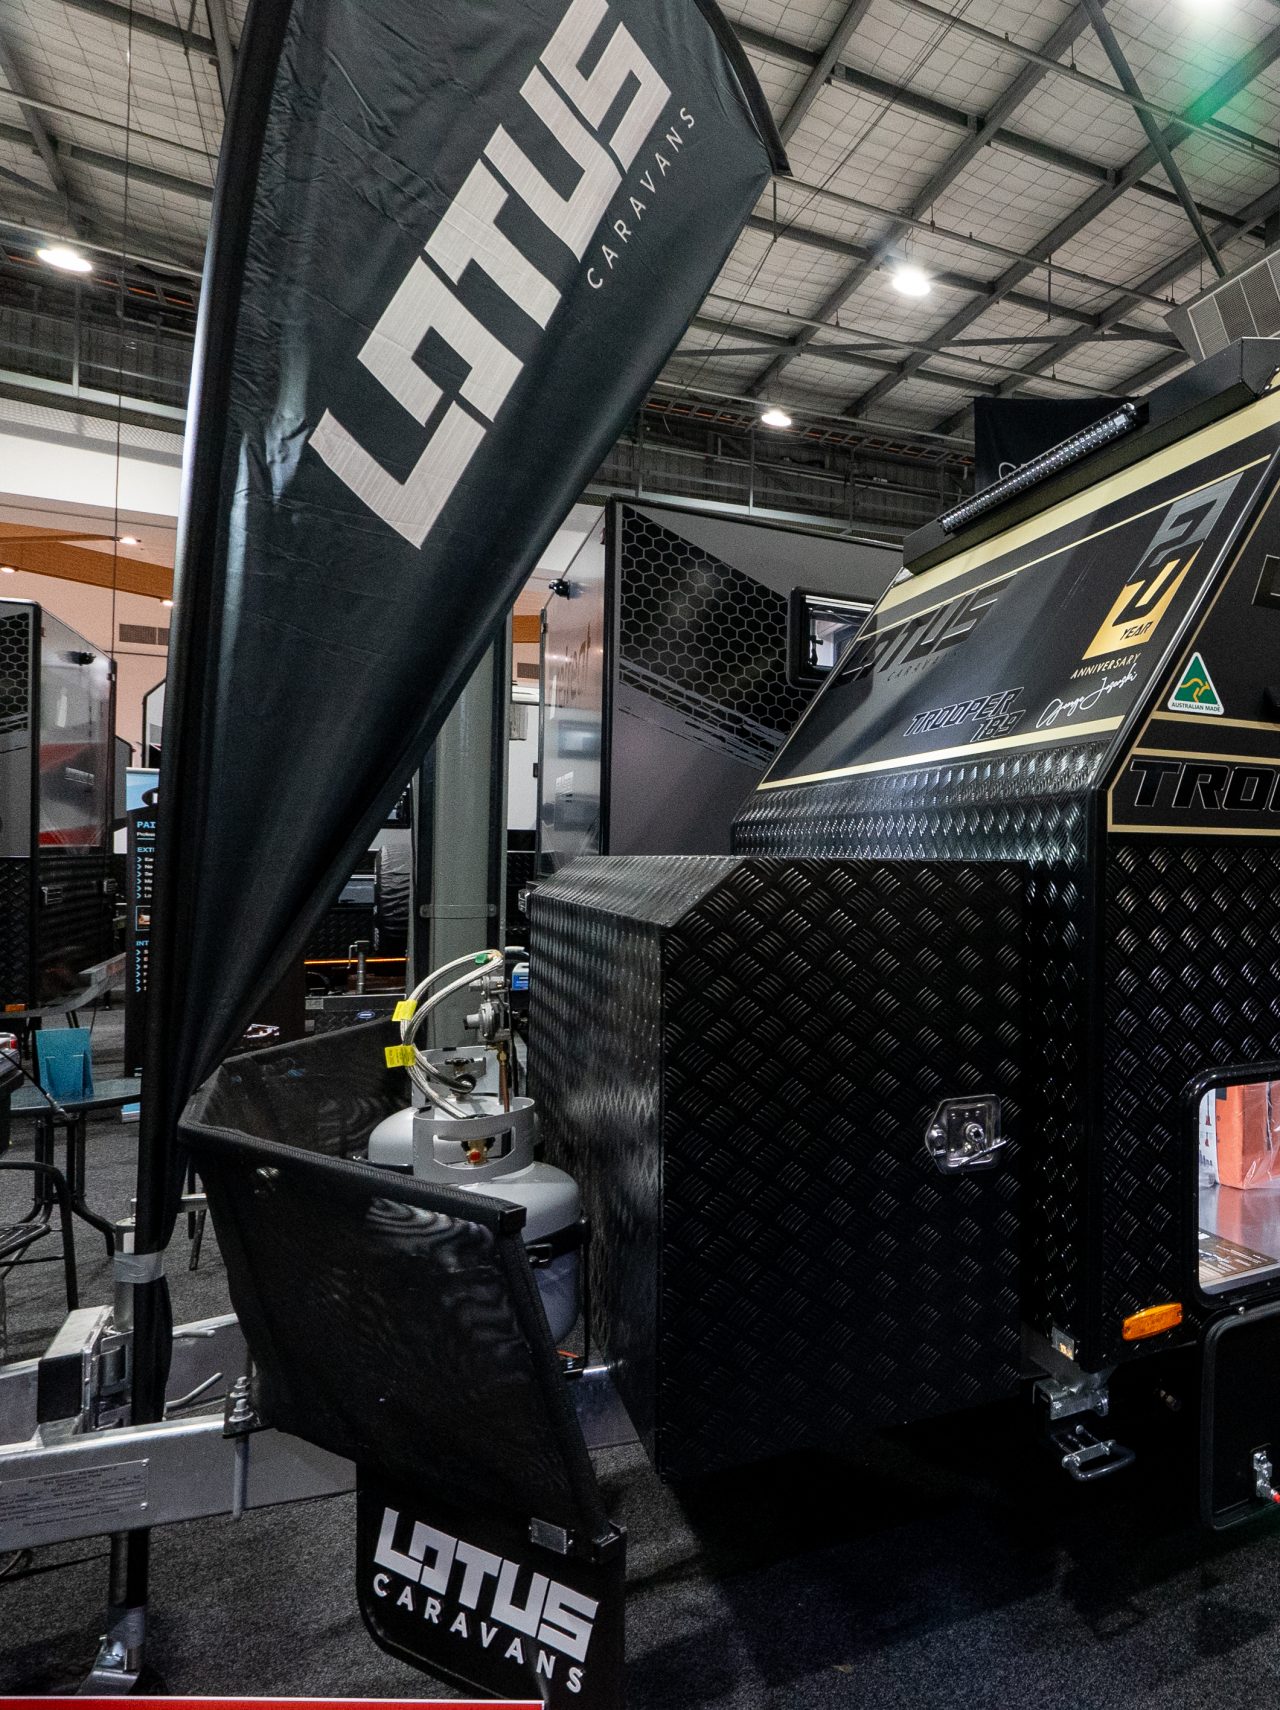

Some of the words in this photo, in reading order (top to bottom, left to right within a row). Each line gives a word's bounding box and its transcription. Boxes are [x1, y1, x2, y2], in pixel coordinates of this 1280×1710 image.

[586, 106, 696, 289] CARAVANS
[310, 0, 671, 550] LOTUS
[1070, 652, 1141, 679] ANNIVERSARY
[1120, 621, 1153, 640] YEAR
[902, 686, 1025, 737] TROOPER
[1171, 701, 1204, 711] AUSTRALIAN
[1204, 704, 1221, 712] MADE
[373, 1506, 599, 1663] LOTUS
[372, 1572, 584, 1694] CARAVANS
